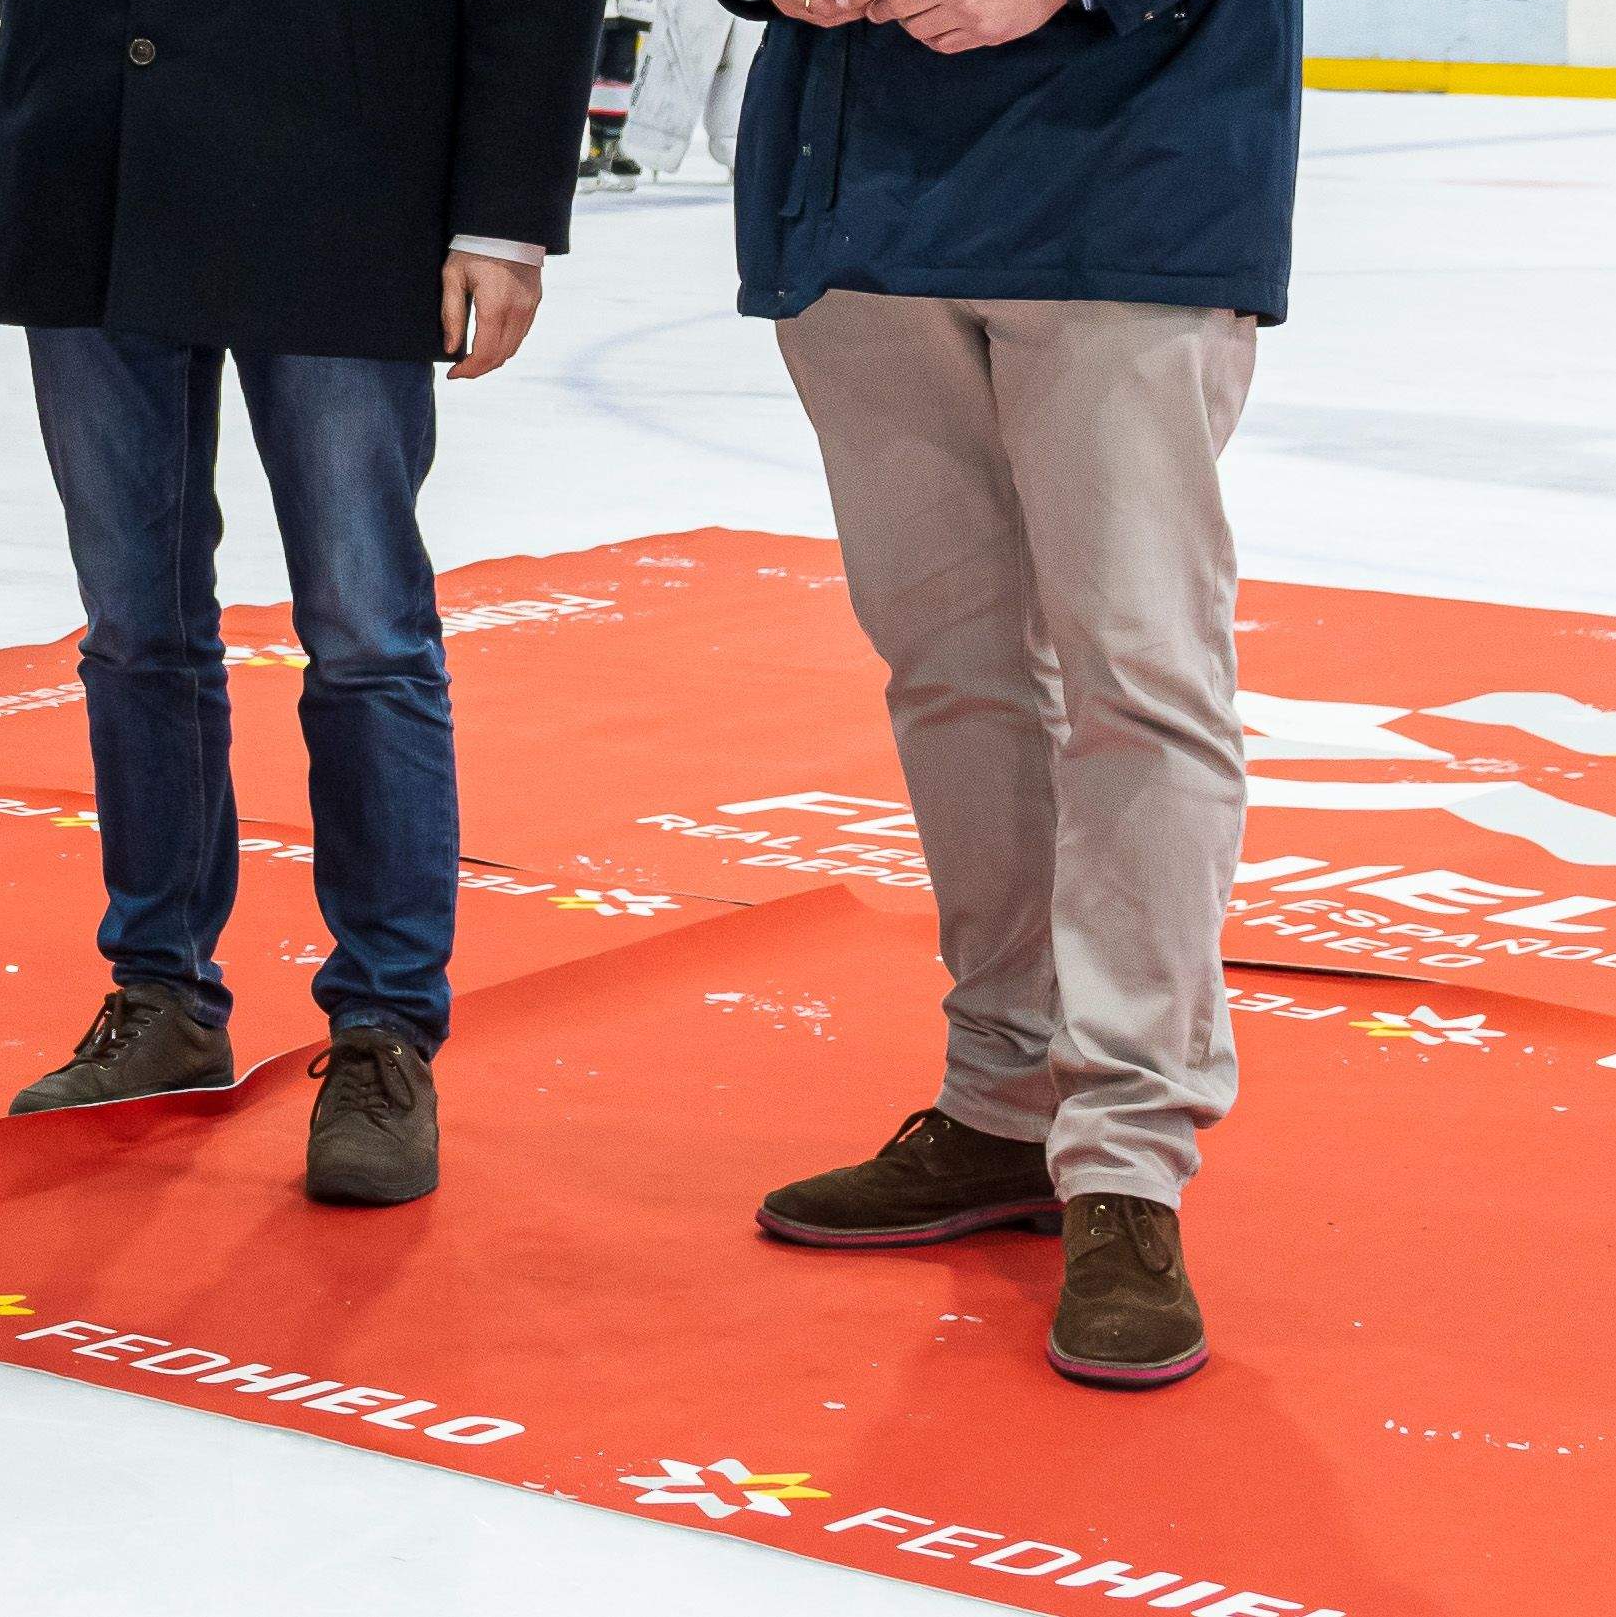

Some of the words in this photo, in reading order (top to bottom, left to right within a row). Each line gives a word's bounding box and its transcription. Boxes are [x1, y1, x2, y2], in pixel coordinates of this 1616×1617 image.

[634, 813, 802, 850] REAL
[1279, 898, 1616, 969] ESPAÑO
[737, 852, 934, 892] DEPO
[1242, 915, 1486, 969] HIELO
[15, 1319, 526, 1445] FEDHIELO
[822, 1506, 1347, 1617] FEDHIE
